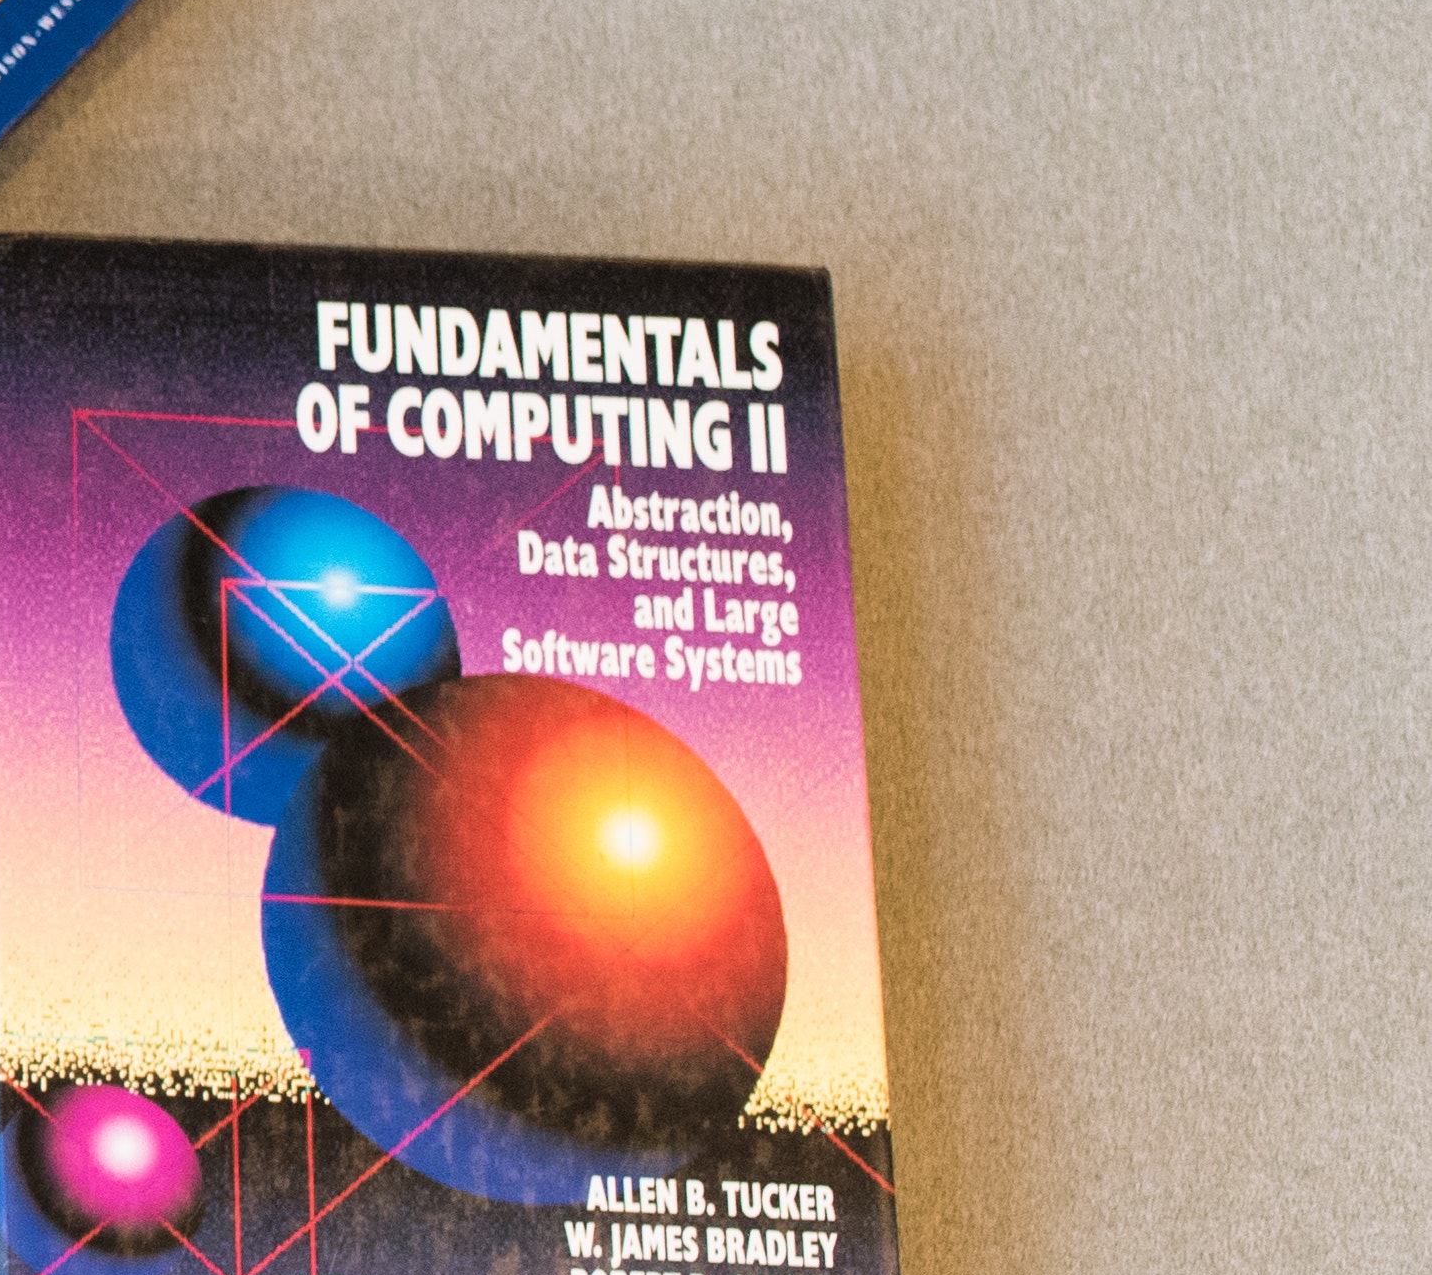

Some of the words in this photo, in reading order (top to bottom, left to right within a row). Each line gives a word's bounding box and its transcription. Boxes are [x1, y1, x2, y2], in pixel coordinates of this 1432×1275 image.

[317, 301, 783, 391] FUNDAMENTALS
[296, 382, 371, 454] OF
[387, 386, 733, 471] COMPUTING
[748, 403, 788, 473] II
[587, 485, 793, 543] Abstraction,
[517, 530, 598, 577] Data
[608, 534, 796, 593] Structures,
[634, 588, 694, 633] and
[704, 588, 799, 645] Large
[502, 628, 655, 679] Software
[665, 636, 802, 691] Systems
[587, 1175, 678, 1215] ALLEN
[686, 1179, 715, 1216] B.
[722, 1181, 835, 1221] TUCKER
[564, 1221, 603, 1258] W.
[611, 1223, 699, 1268] JAMES
[706, 1227, 837, 1268] BRADLEY
